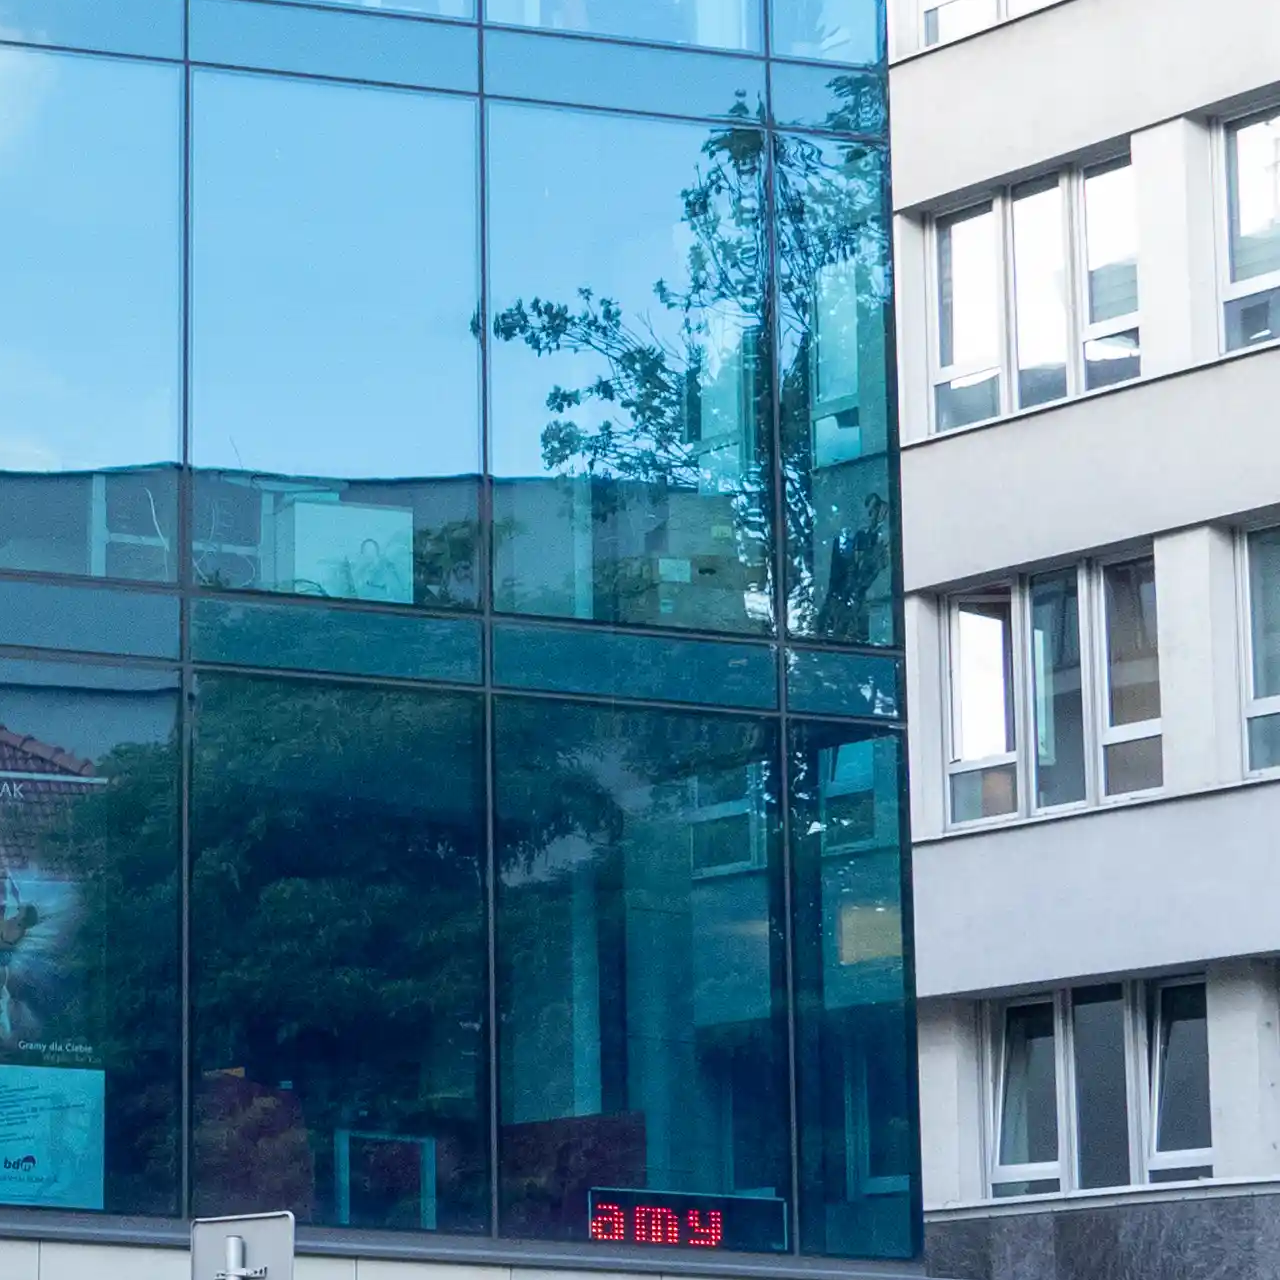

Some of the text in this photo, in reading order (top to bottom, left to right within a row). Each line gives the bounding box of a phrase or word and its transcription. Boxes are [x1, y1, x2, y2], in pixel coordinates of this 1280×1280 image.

[18, 1041, 46, 1052] Gramy
[49, 1042, 63, 1051] dla
[3, 1155, 36, 1171] bdm
[592, 1204, 721, 1246] amy
